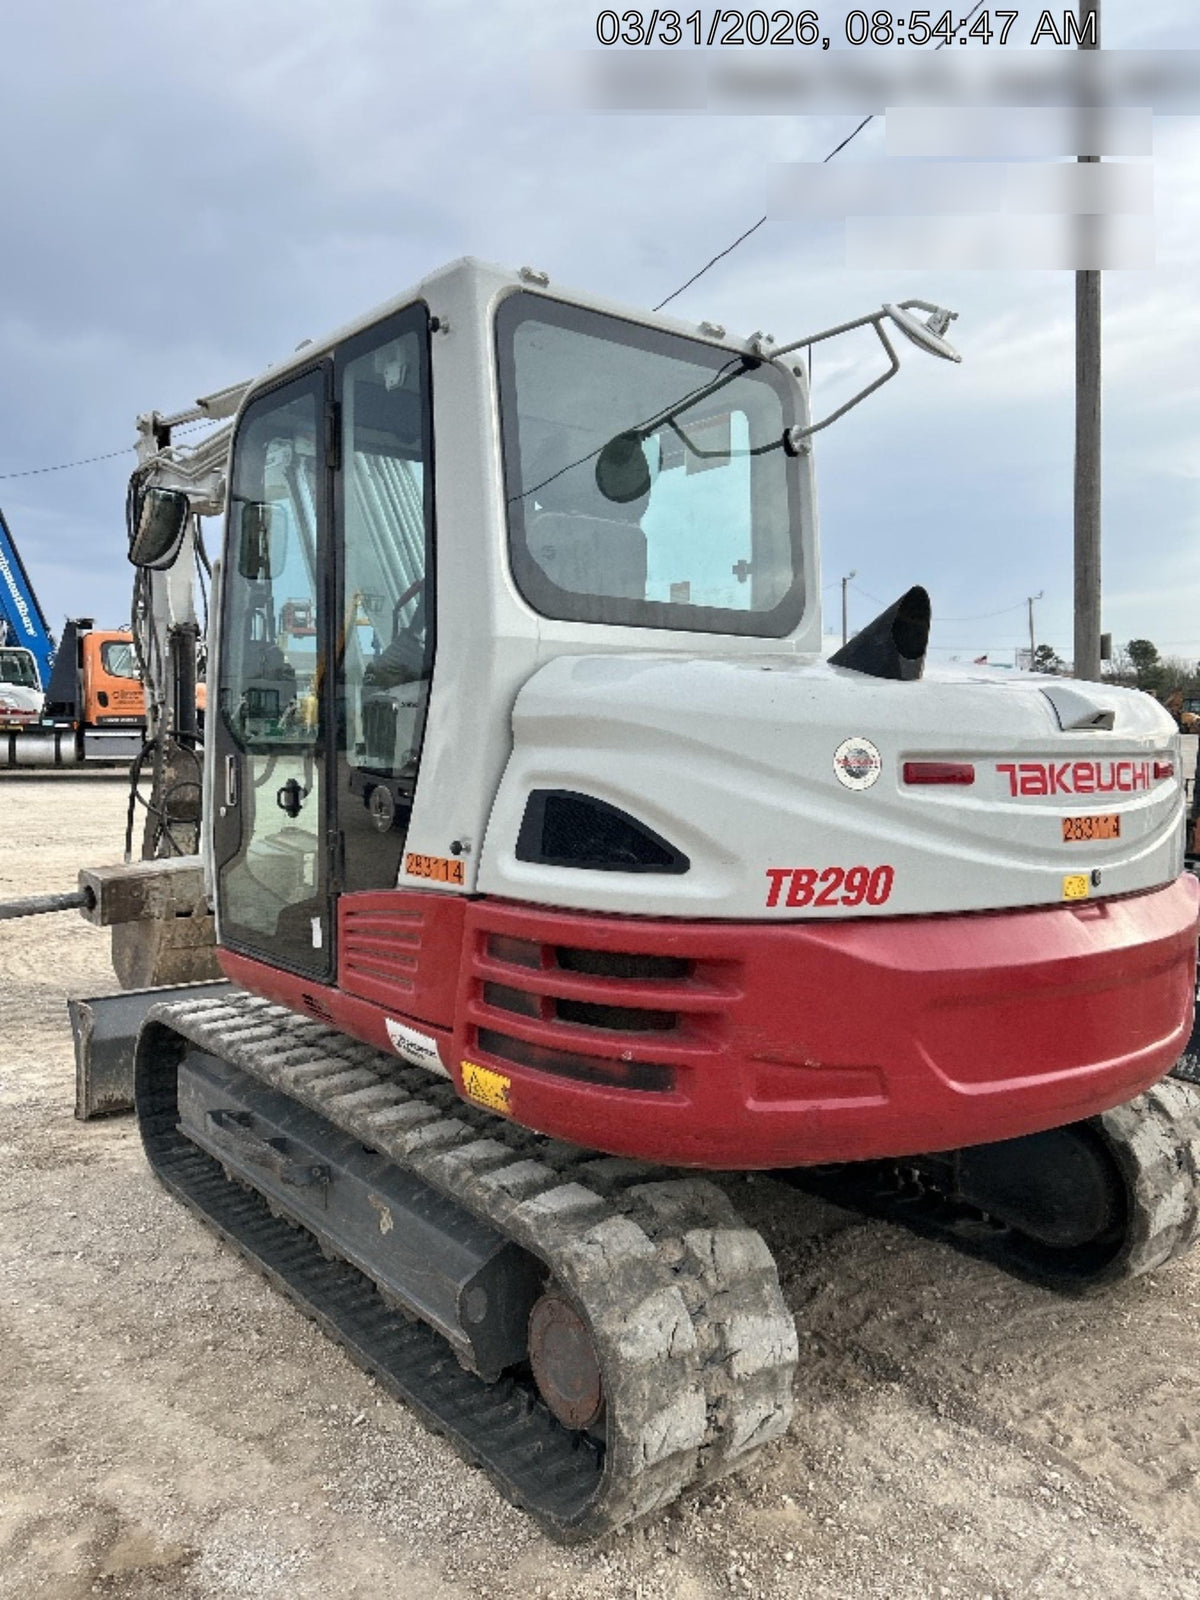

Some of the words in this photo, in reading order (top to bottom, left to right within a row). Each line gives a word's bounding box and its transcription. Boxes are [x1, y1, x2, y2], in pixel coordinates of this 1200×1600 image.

[1063, 815, 1120, 841] 283114
[406, 853, 464, 884] 283114
[765, 865, 894, 907] TB290
